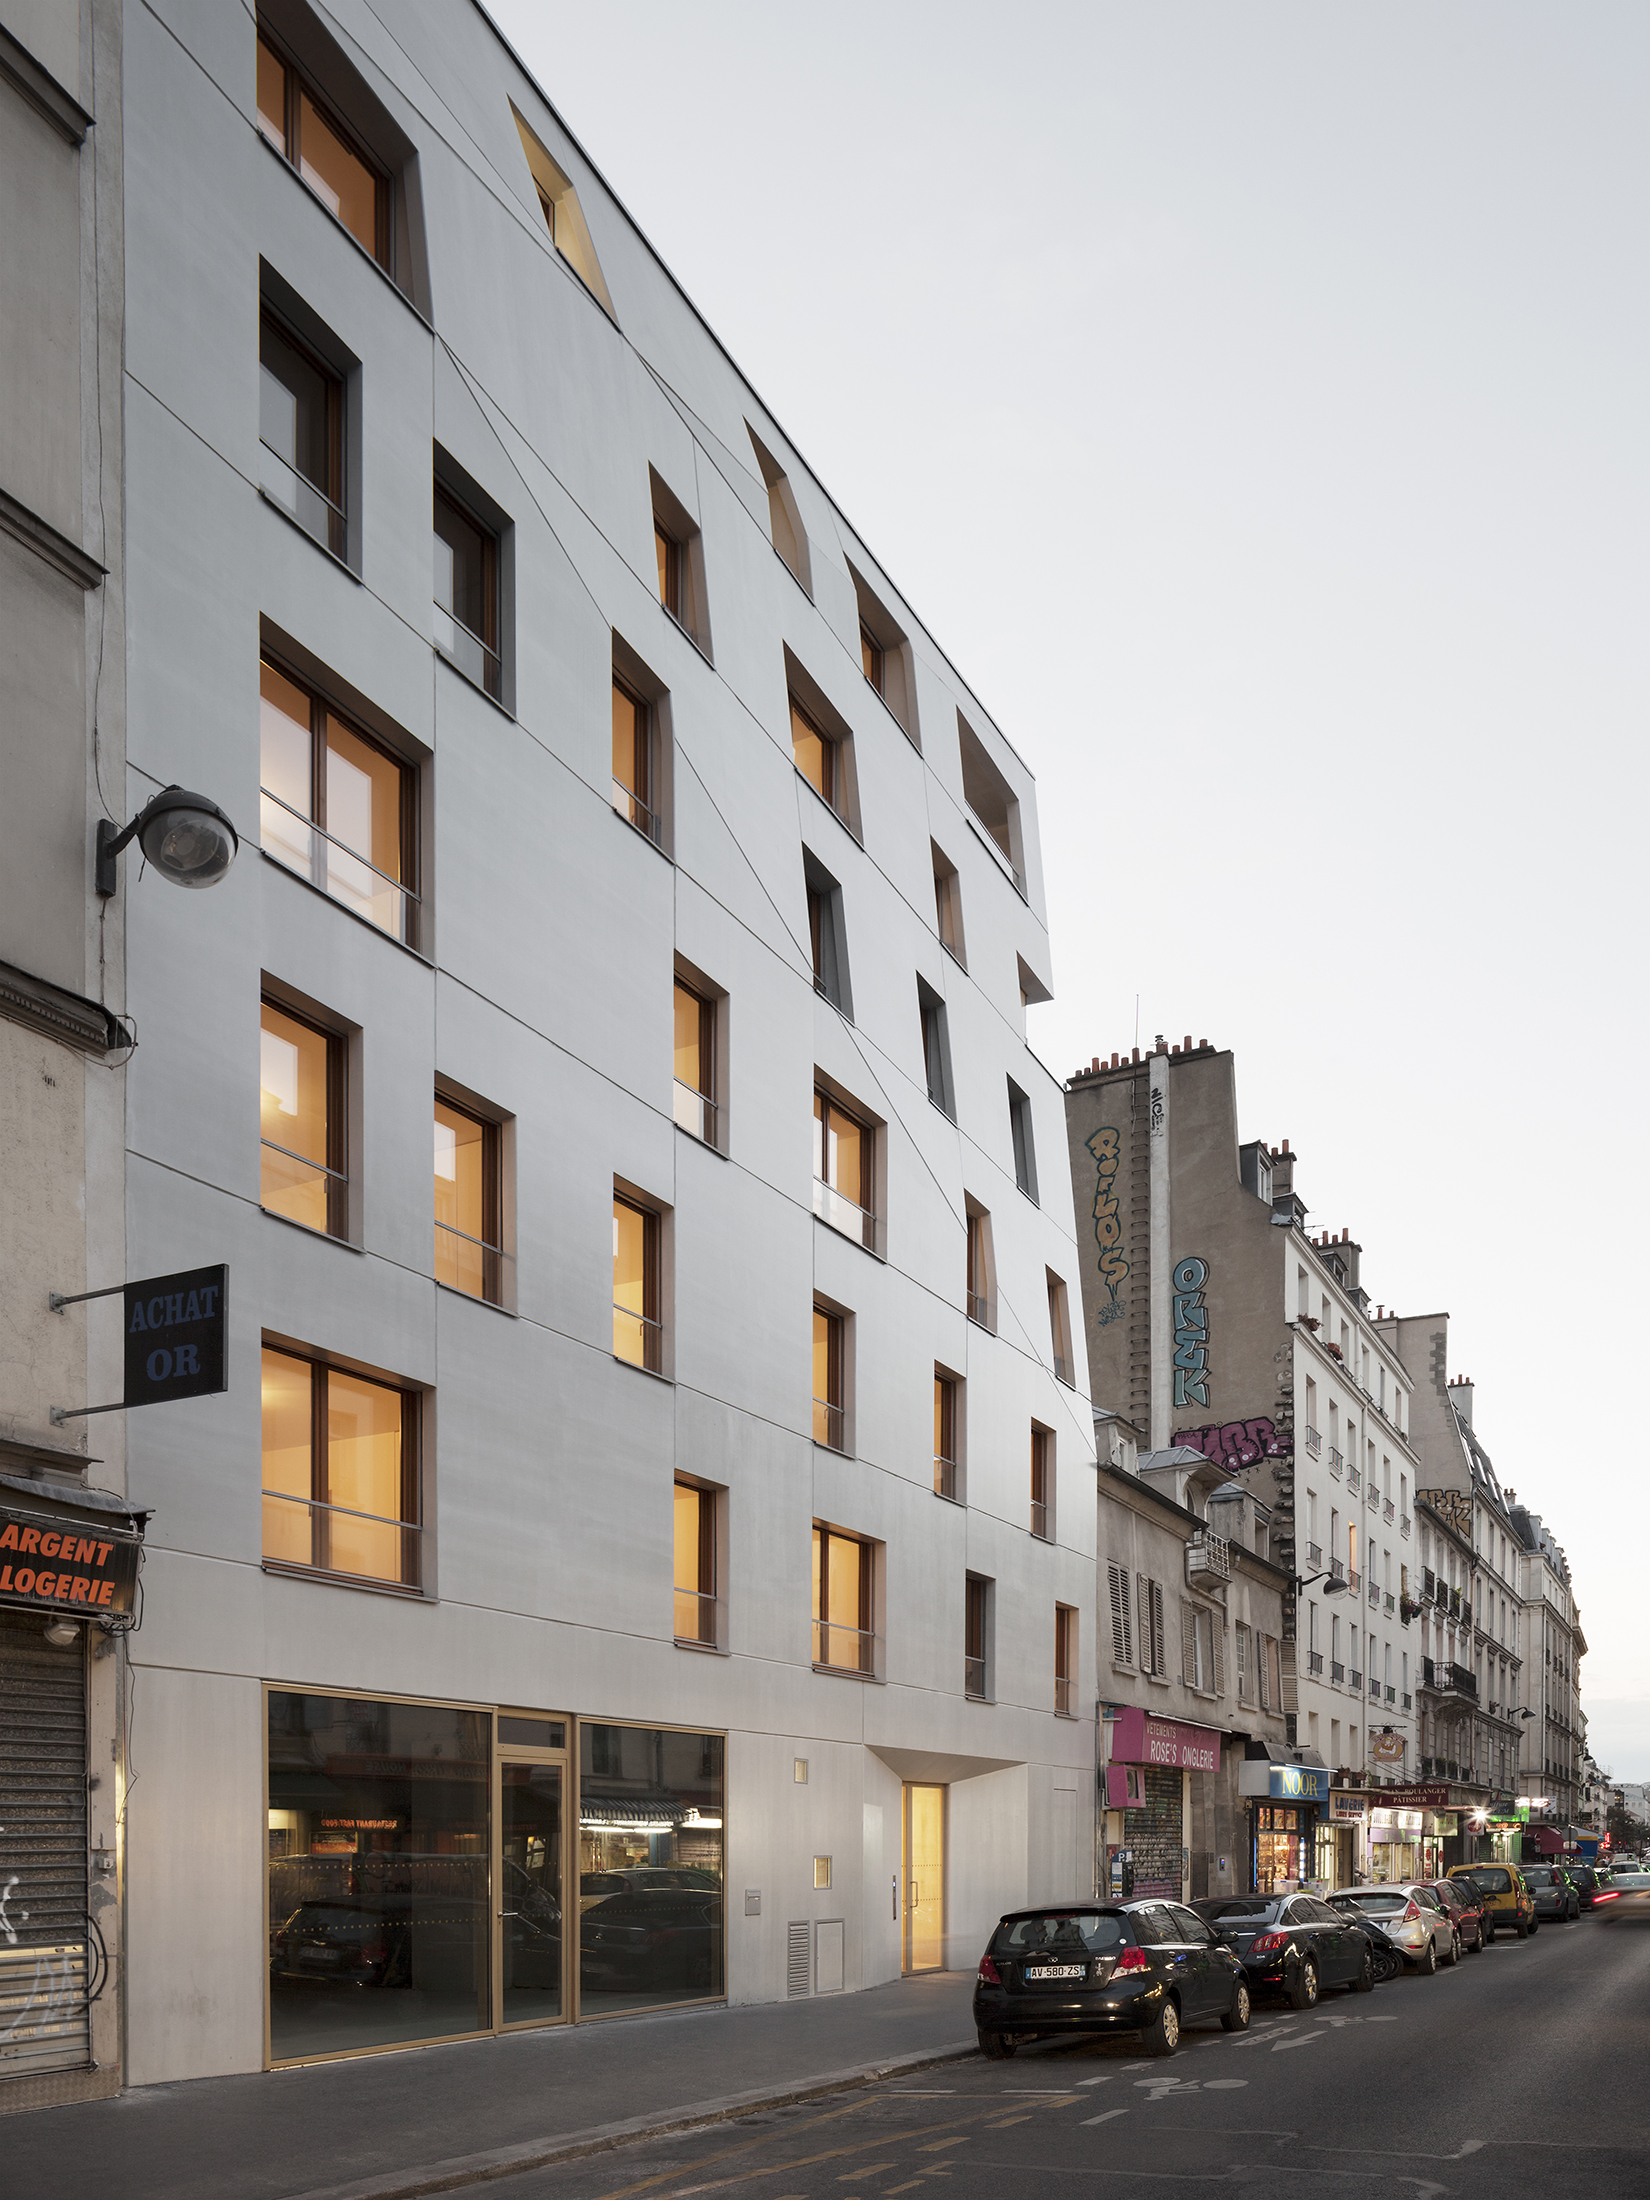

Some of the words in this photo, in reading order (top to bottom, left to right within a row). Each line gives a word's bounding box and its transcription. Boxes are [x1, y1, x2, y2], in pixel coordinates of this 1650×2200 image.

[129, 1285, 219, 1333] ACHAT
[146, 1344, 201, 1381] OR
[0, 1524, 114, 1567] ARGENT
[0, 1565, 115, 1605] LOGERIE
[1146, 1722, 1177, 1739] VETEMENTS
[1150, 1740, 1177, 1764] ROSE'S
[1182, 1746, 1214, 1769] ONGLERIE
[1282, 1771, 1318, 1796] NOOR
[1335, 1796, 1365, 1811] LAVERIE
[1393, 1795, 1428, 1803] PÂTISSIER
